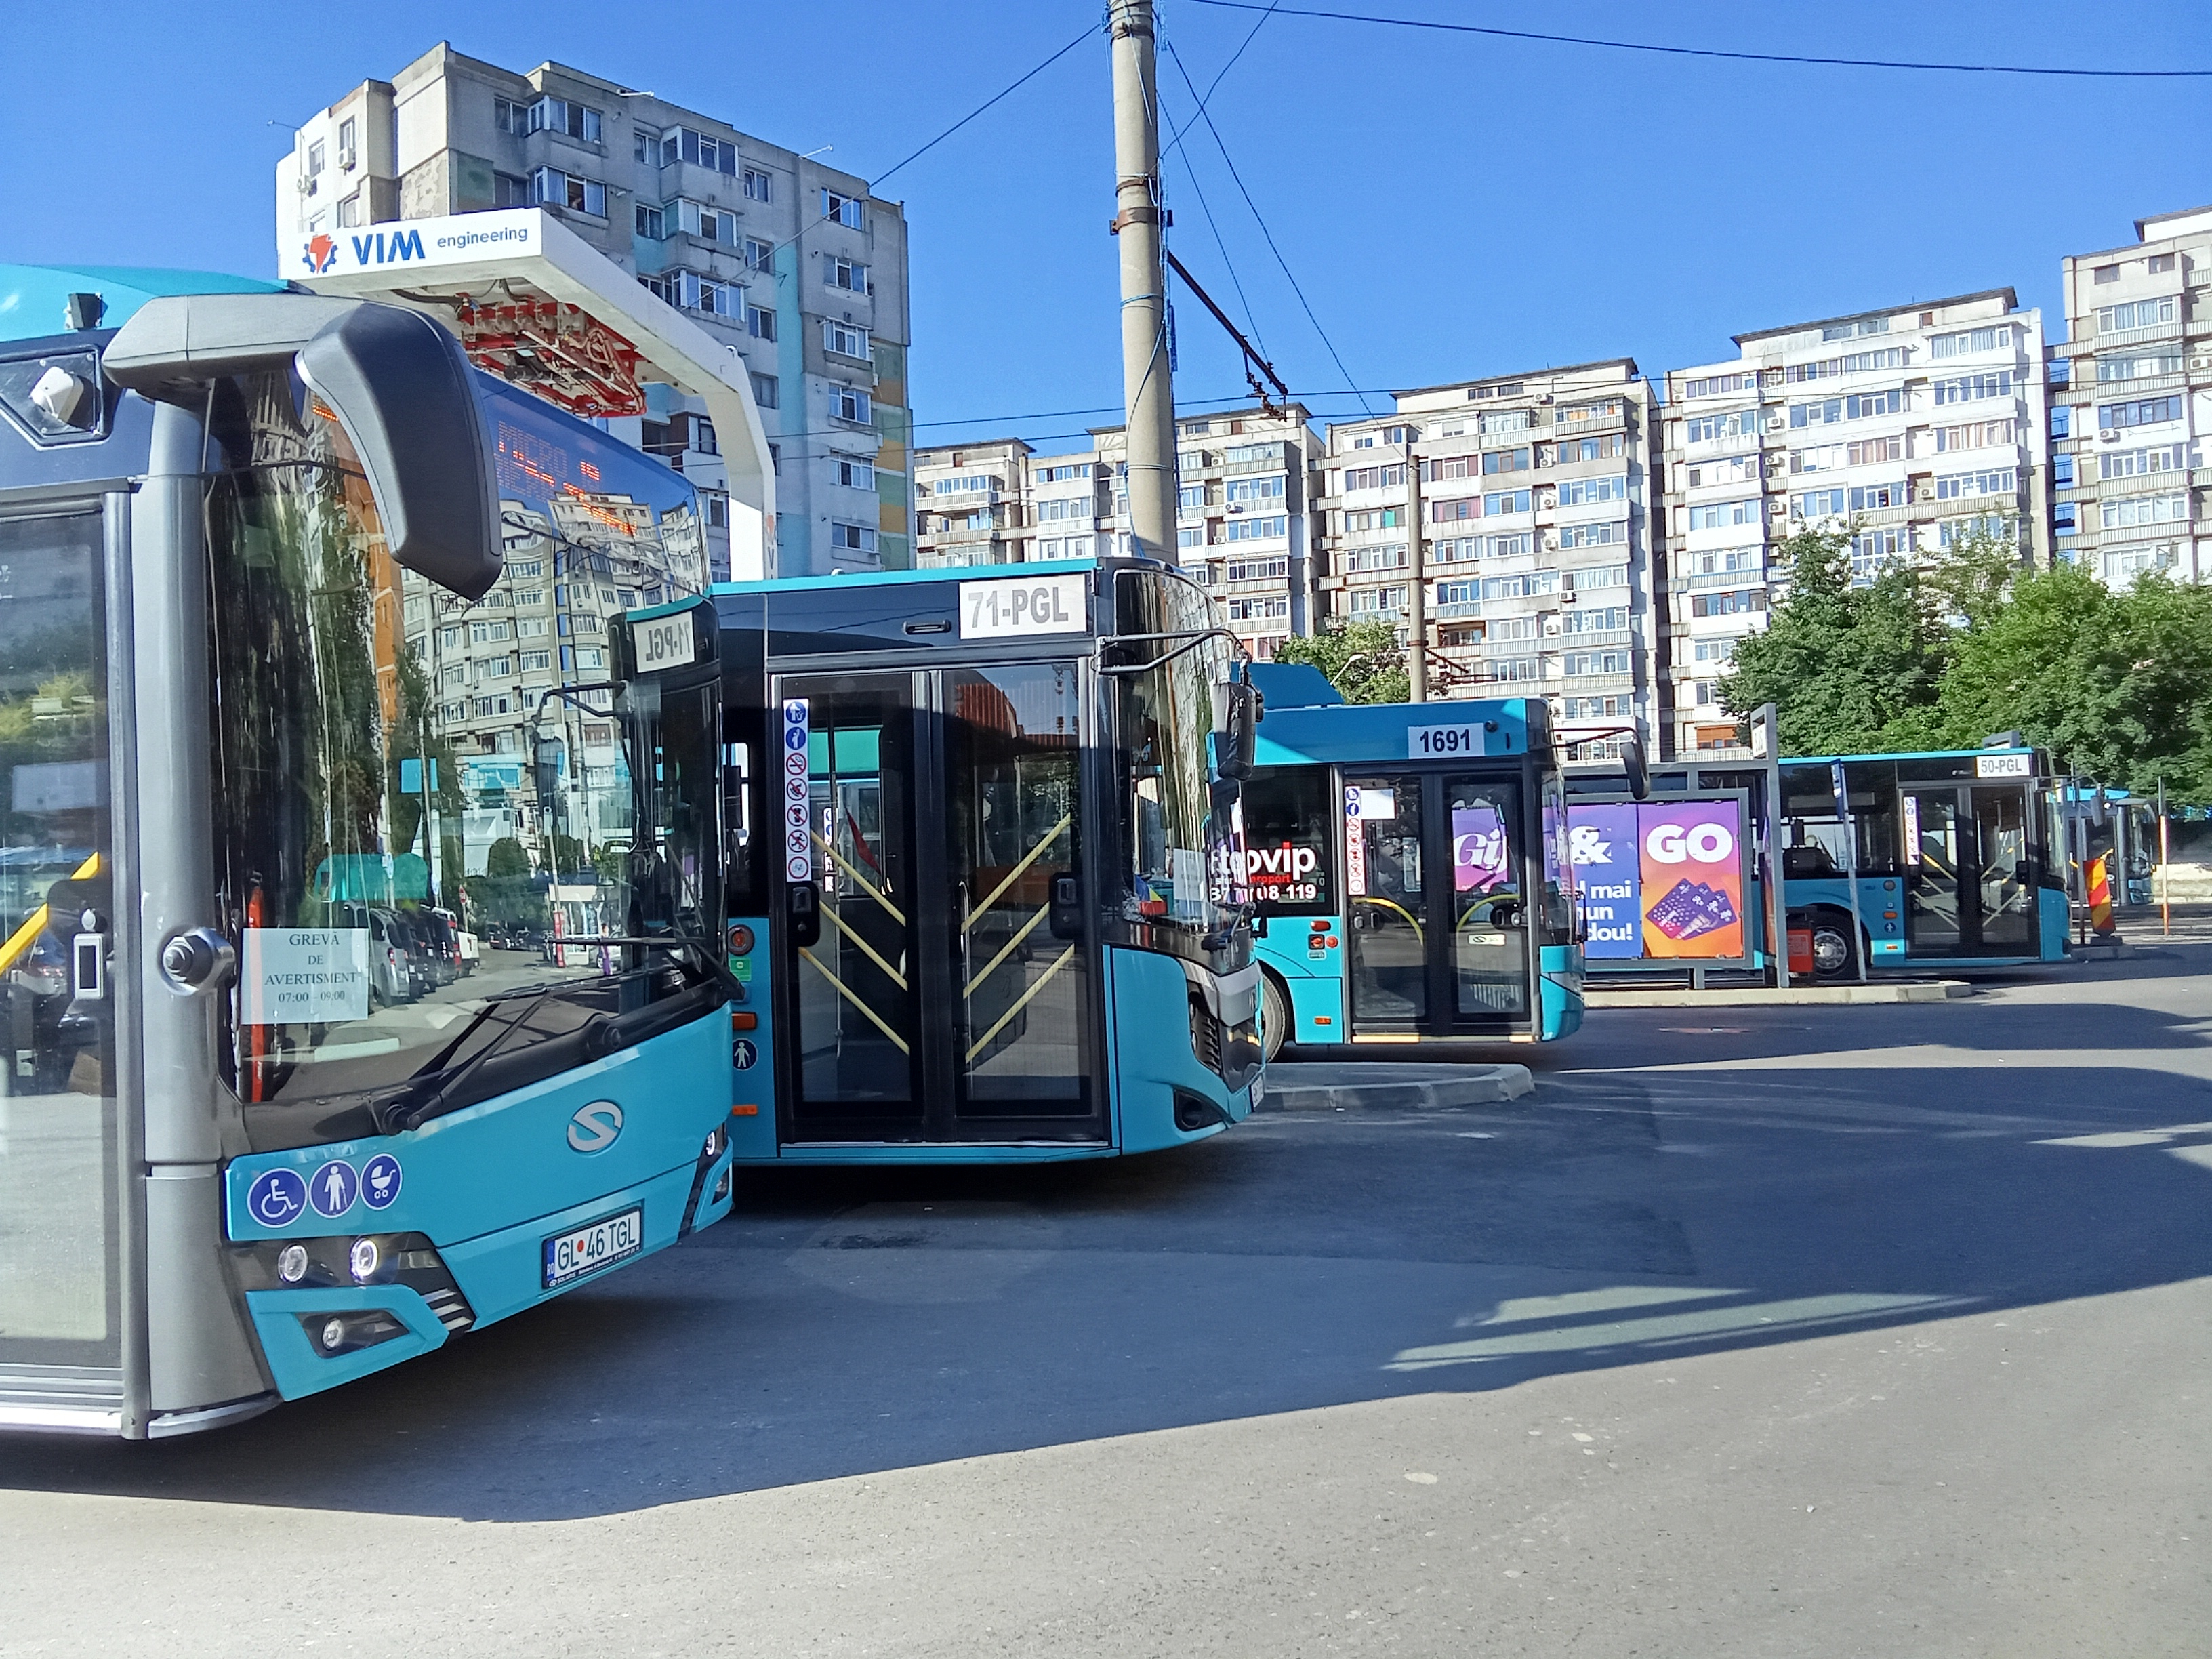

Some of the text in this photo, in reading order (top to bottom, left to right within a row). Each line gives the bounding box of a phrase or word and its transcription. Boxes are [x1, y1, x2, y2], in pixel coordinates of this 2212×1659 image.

[351, 227, 528, 265] VIM engineering
[968, 586, 1069, 628] 71-PGL
[1420, 729, 1470, 752] 1691
[1982, 758, 2022, 773] 50-PGL
[1646, 823, 1733, 864] GO
[1286, 884, 1317, 900] 119
[1590, 880, 1631, 899] mai
[1587, 922, 1633, 941] dou!
[308, 955, 324, 965] DE
[264, 972, 356, 985] AVERTISMENT
[279, 992, 309, 1002] 07:00
[321, 991, 345, 1001] 09:00
[558, 1239, 579, 1270] GL
[587, 1228, 605, 1259] 46
[609, 1218, 636, 1252] TGL
[546, 1262, 555, 1277] RO
